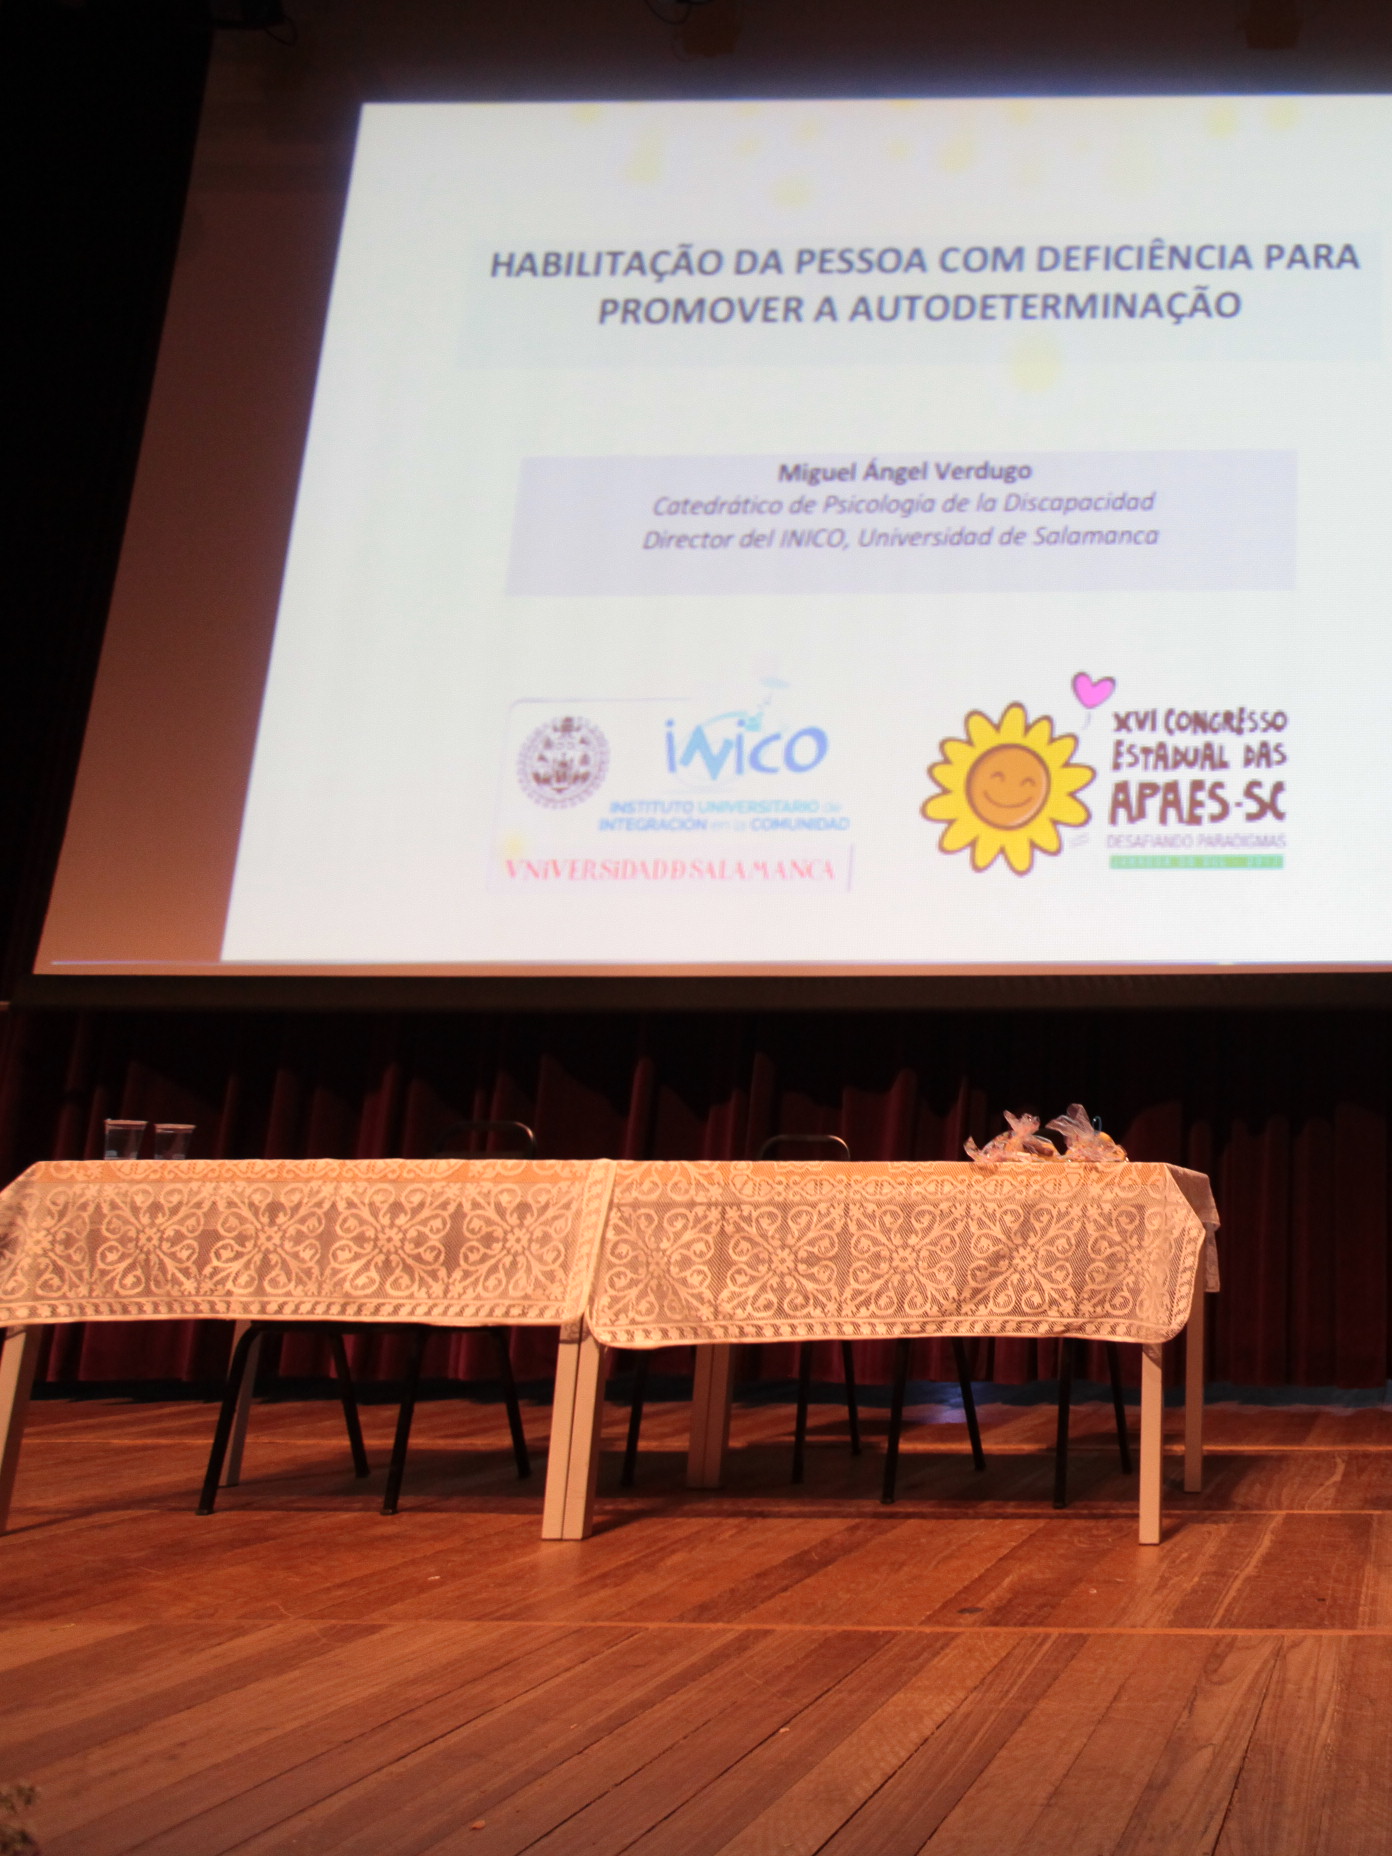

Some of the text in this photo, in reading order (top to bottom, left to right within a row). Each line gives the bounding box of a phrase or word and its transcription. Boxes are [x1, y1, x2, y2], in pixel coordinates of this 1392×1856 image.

[490, 237, 1361, 282] HABILITAÇÃO DA PESSOA COM DEFICIÊNCIA PARA
[598, 285, 1243, 325] PROMOVER A AUTODETERMINAÇÃO
[778, 458, 1033, 485] Miguel Ángel Verdugo
[652, 491, 1157, 518] Catedrático de Psicología de la Discapacidad
[642, 526, 1160, 551] Director del INICO, Universidad de Salamanca
[1113, 707, 1288, 735] XVI CONGRESSO
[1112, 739, 1288, 771] ESTADUAL DAS
[609, 800, 695, 815] INSTITUTO
[698, 799, 821, 814] UNIVERSITARIO
[1109, 779, 1287, 826] APAES-SC
[749, 816, 851, 832] COMUNIDAD
[1107, 833, 1288, 849] DESAFIANDO PARADIGMAS
[688, 857, 836, 881] SALAMANCA
